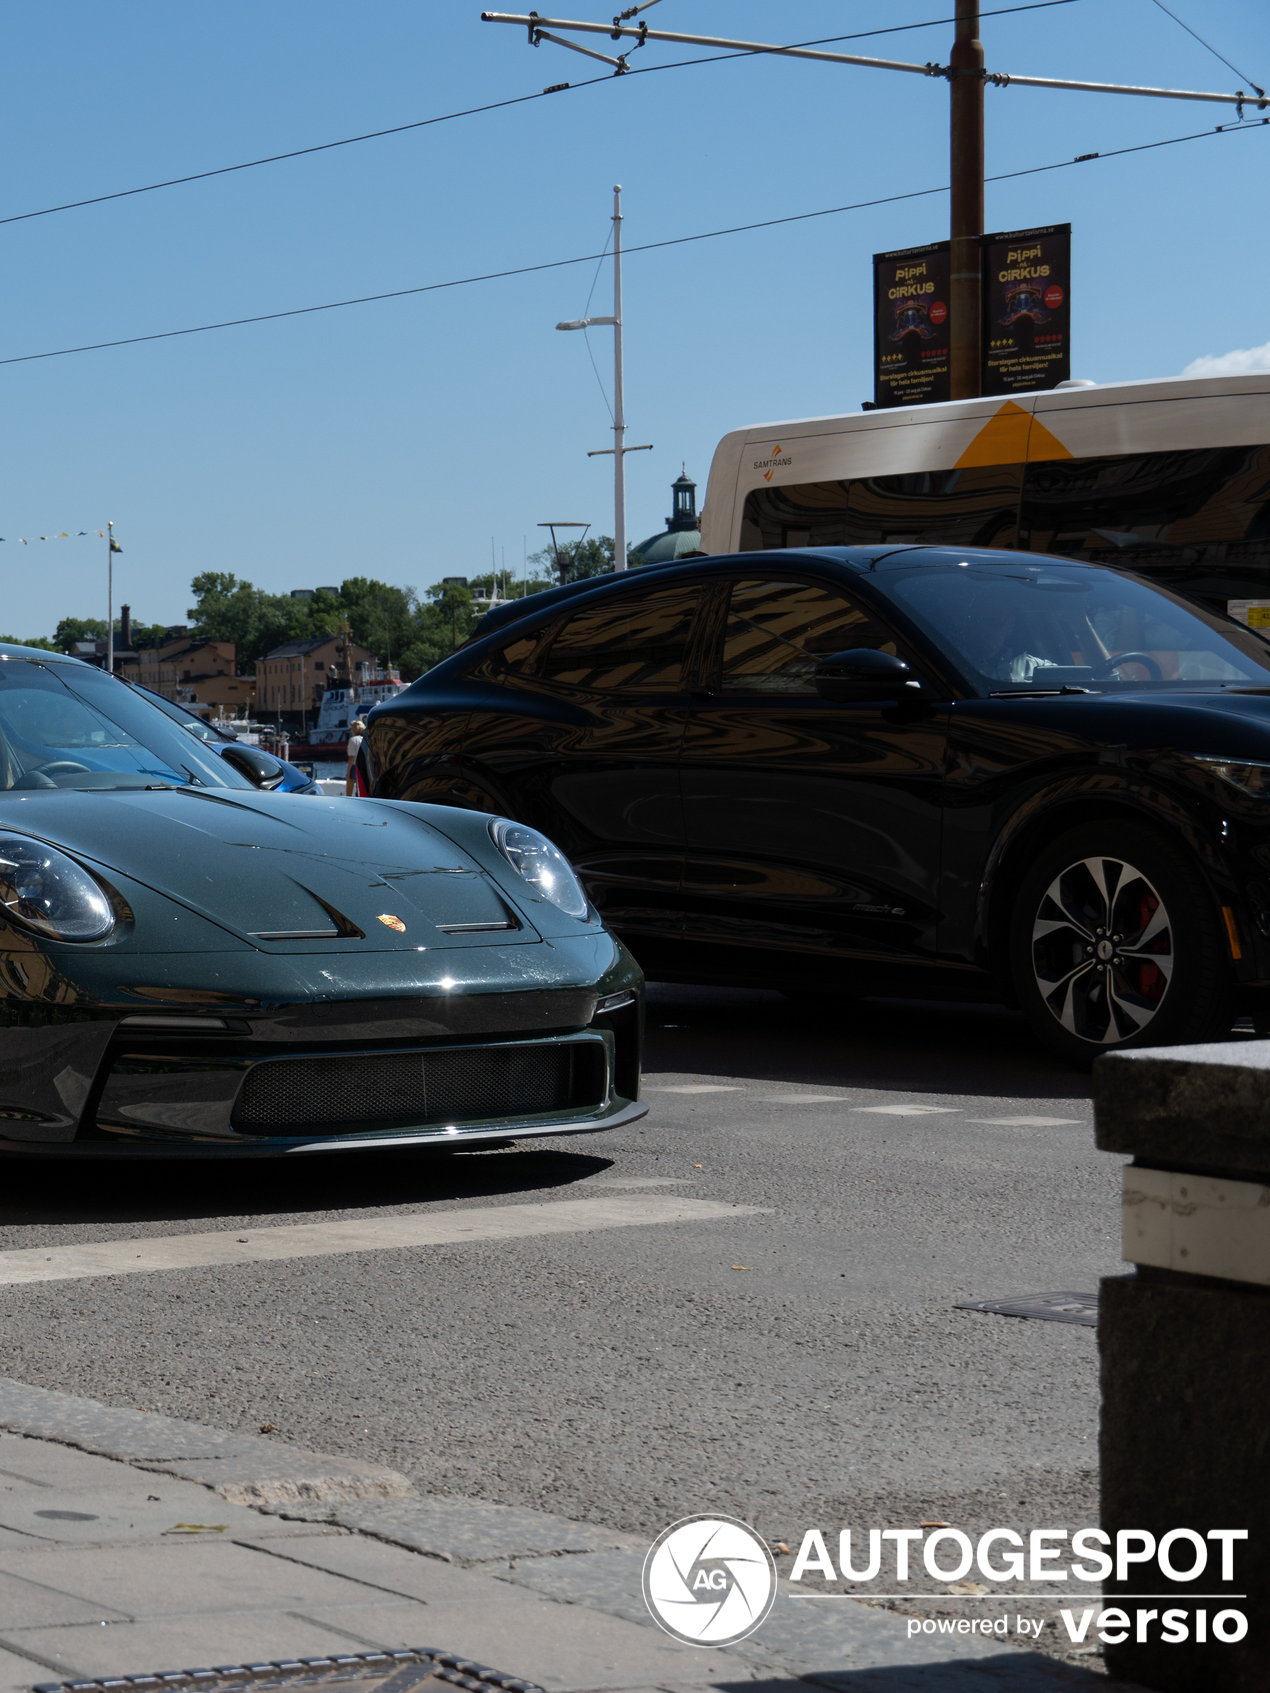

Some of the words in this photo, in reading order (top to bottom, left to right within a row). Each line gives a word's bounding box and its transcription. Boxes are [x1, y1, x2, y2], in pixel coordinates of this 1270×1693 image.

[987, 357, 1019, 367] Storslagen
[1018, 352, 1063, 363] cirkusmusikal
[1008, 364, 1022, 372] hela
[1022, 361, 1049, 371] familjen!
[879, 371, 908, 381] Storslagen
[907, 366, 948, 377] cirkusmusikal
[890, 379, 899, 387] för
[898, 377, 911, 386] hela
[910, 375, 935, 385] familjen!
[753, 457, 792, 470] SAMTRANS
